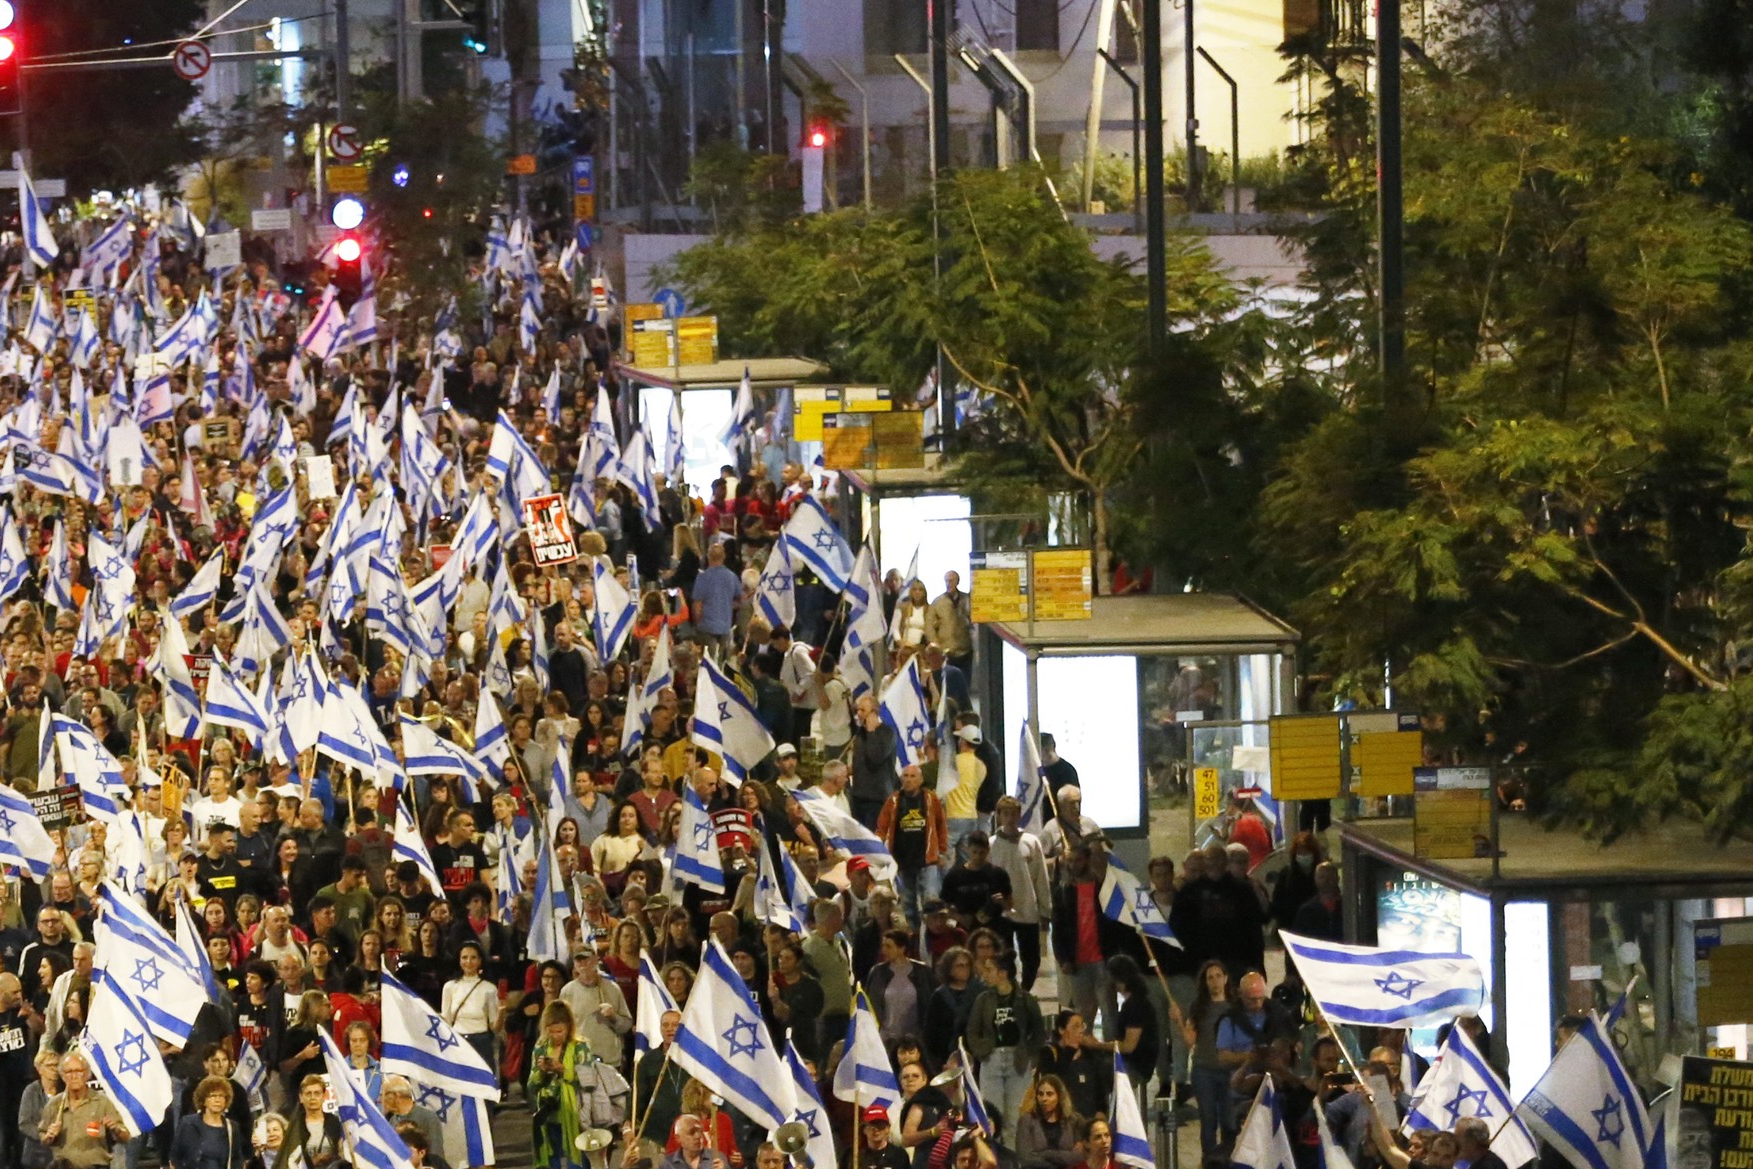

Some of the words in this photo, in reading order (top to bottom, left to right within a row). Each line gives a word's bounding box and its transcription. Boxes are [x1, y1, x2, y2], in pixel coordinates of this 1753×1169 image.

[1202, 770, 1214, 780] 47
[1204, 782, 1215, 791] 51
[1202, 793, 1215, 804] 60
[1198, 805, 1215, 816] 501
[1683, 1083, 1720, 1105] הבית
